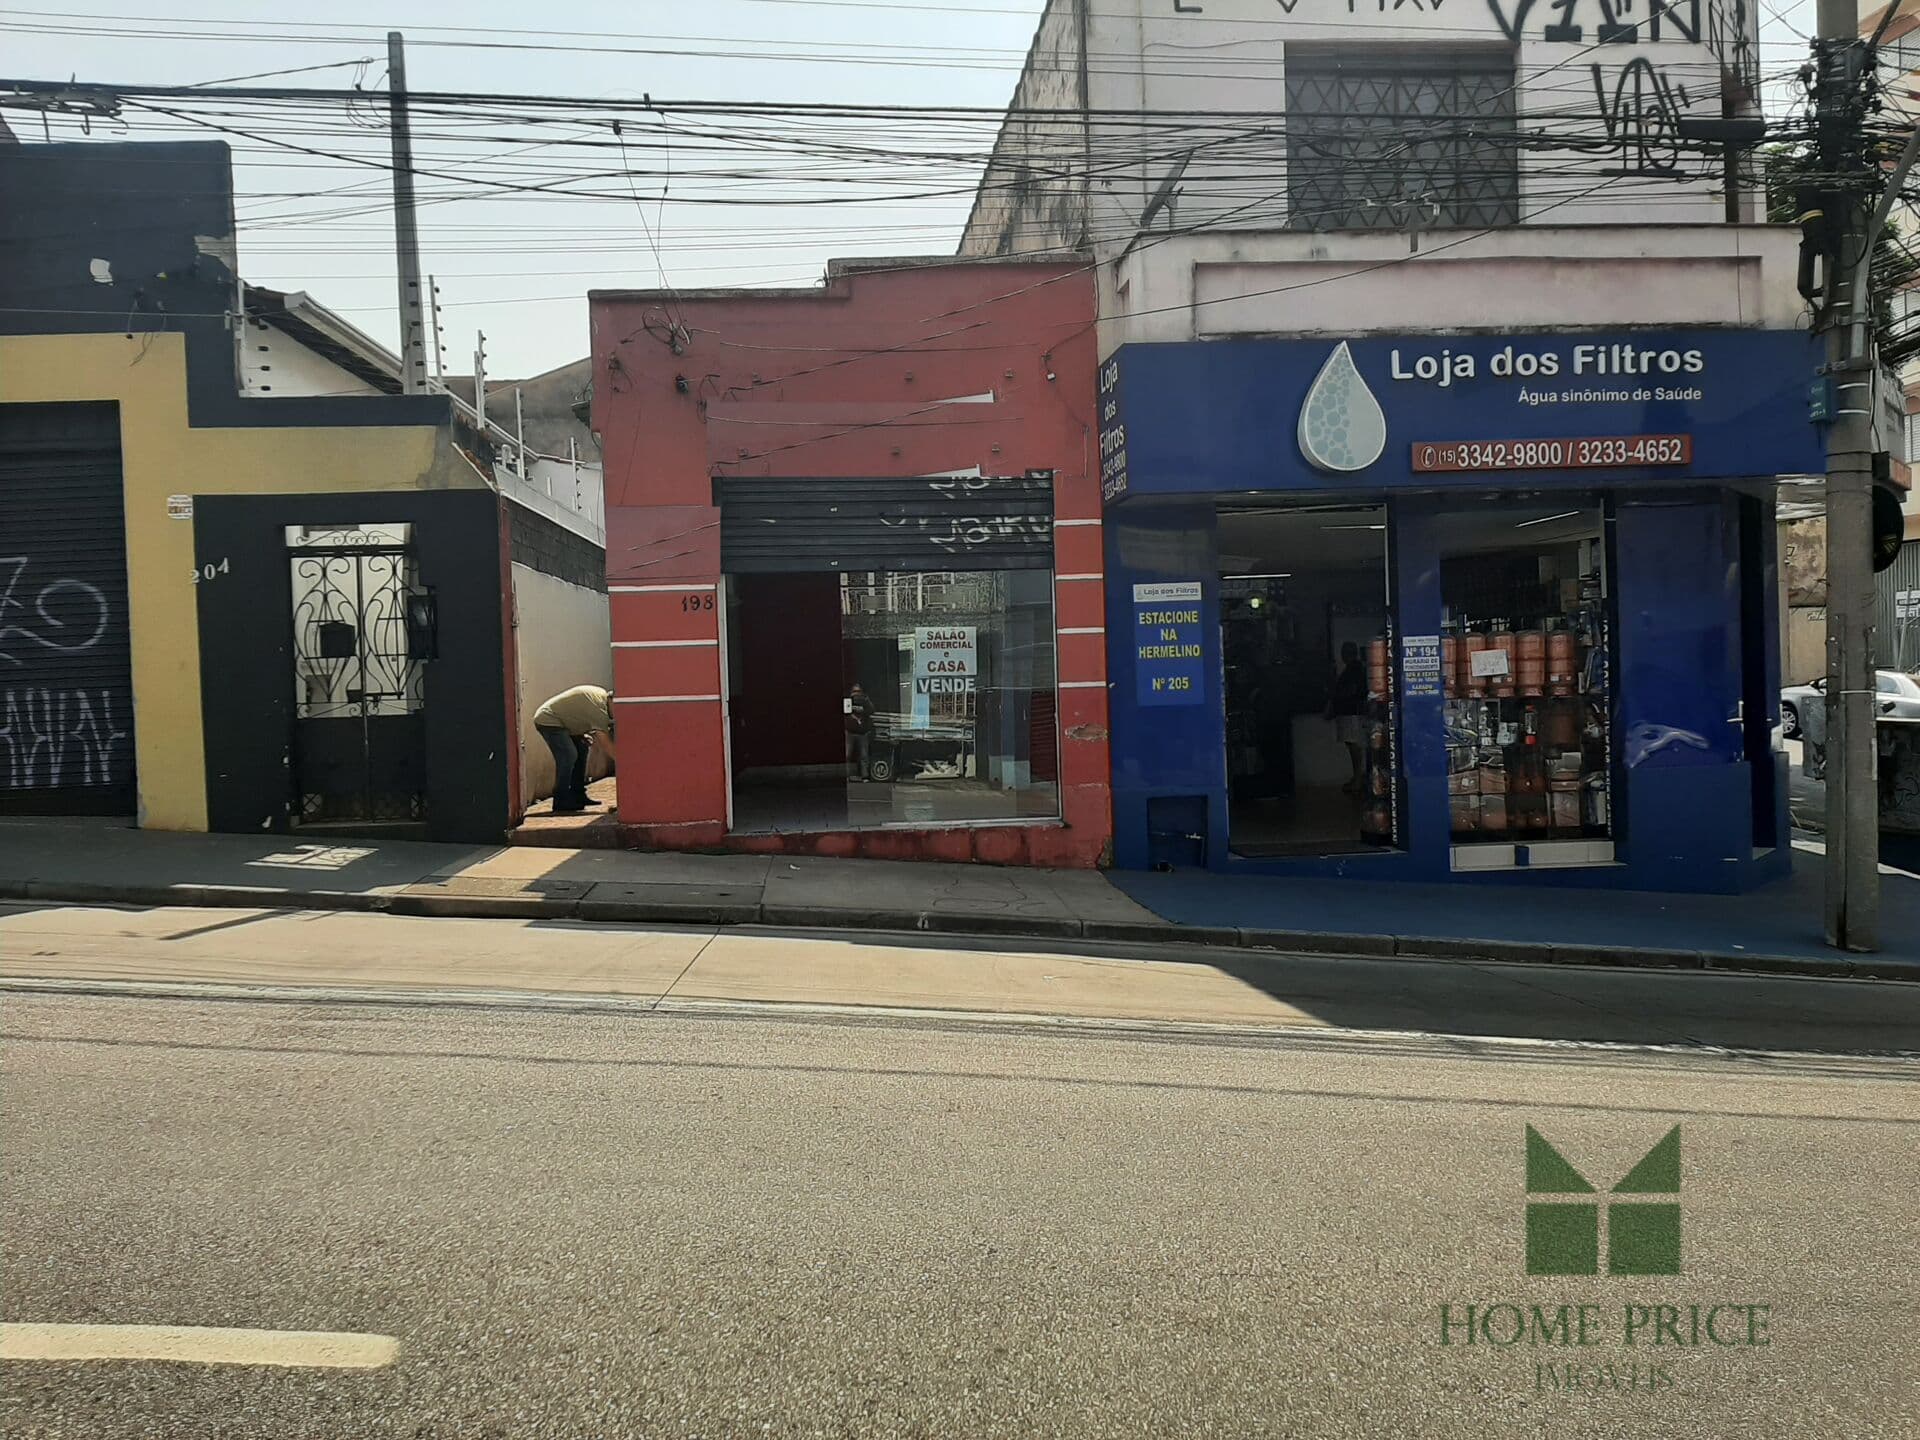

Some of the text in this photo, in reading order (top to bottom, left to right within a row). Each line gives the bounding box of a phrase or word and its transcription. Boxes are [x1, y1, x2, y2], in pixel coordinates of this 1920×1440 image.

[1391, 344, 1704, 387] Loja dos Filtros
[1101, 360, 1118, 394] Loja
[1518, 386, 1702, 405] Água sinônimo de Saúde
[1104, 400, 1116, 422] dos
[1100, 425, 1124, 459] Filtros
[1438, 448, 1456, 464] (15)
[1457, 441, 1562, 468] 3342-9800
[1579, 438, 1682, 464] 3233-4652
[682, 594, 713, 611] 198
[1139, 611, 1199, 625] ESTACIONE
[926, 628, 966, 641] SALÃO
[1160, 628, 1177, 641] NA
[920, 641, 973, 649] COMERCIAL
[1139, 644, 1200, 659] HERMELINO
[1420, 646, 1437, 657] 194
[927, 660, 966, 673] CASA
[918, 678, 977, 694] VENDE
[1168, 677, 1189, 690] 205
